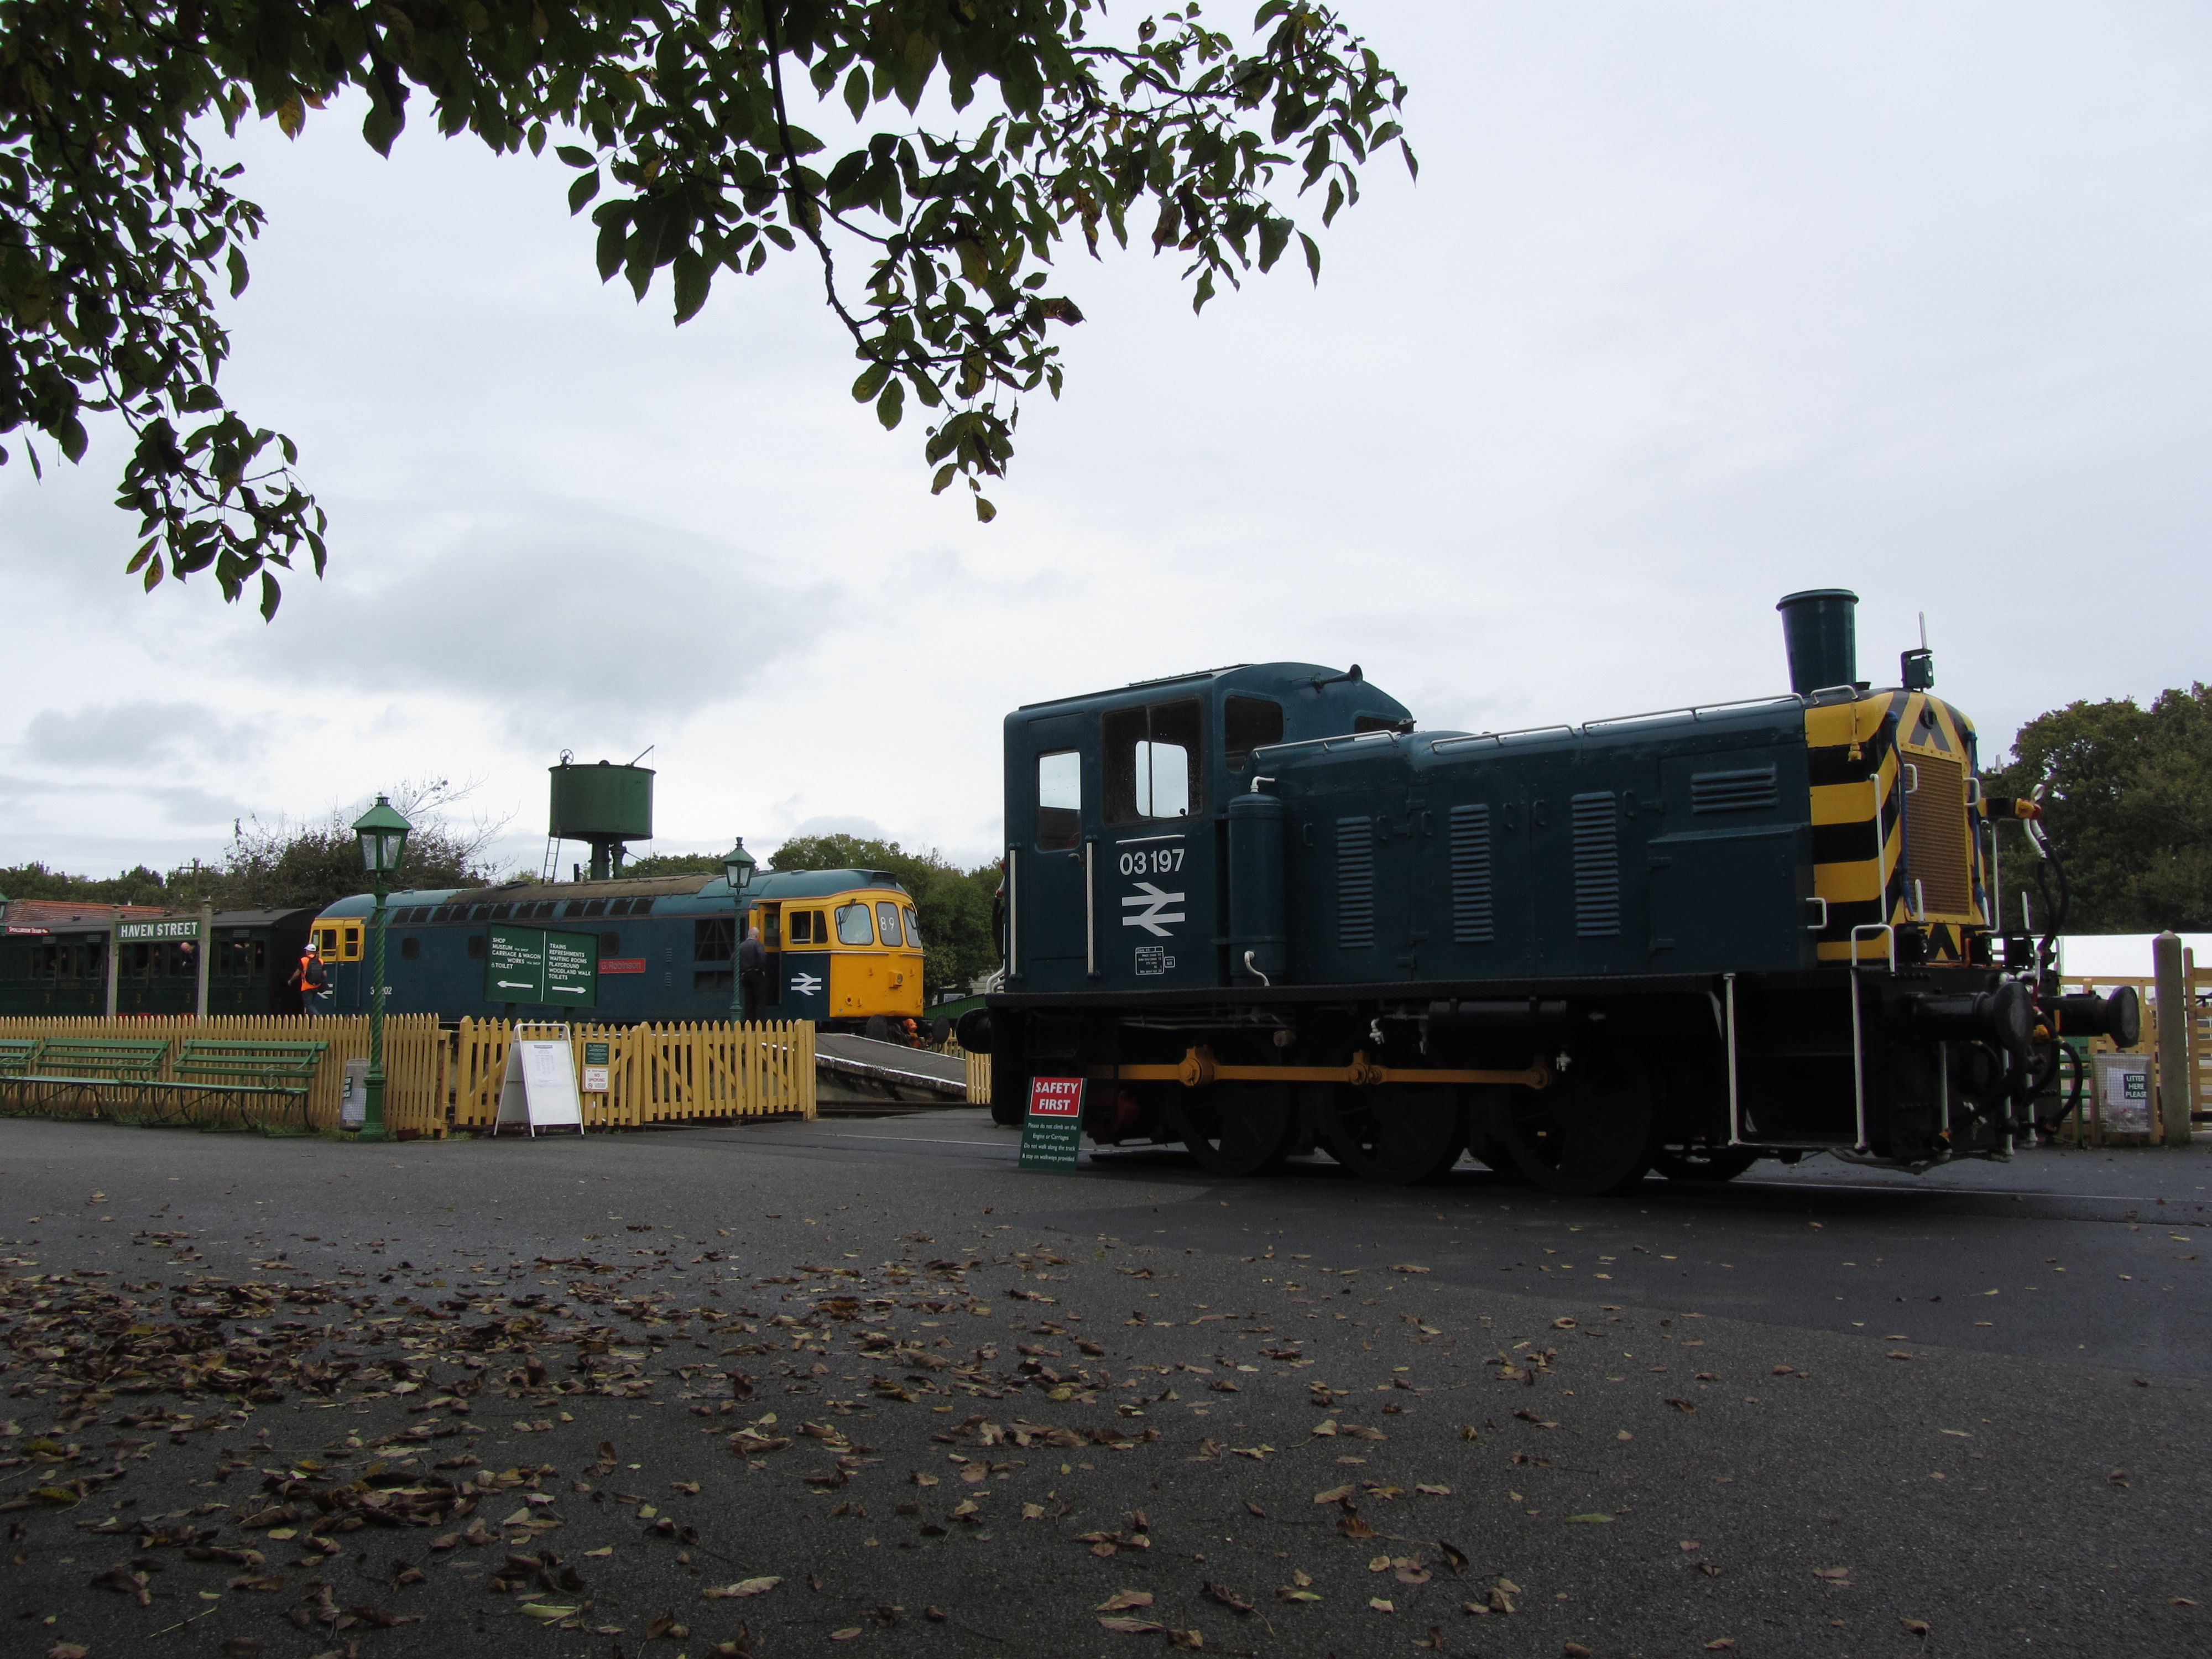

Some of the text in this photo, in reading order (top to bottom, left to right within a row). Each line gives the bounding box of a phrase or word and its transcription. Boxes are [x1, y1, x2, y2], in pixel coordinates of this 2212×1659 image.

[1119, 848, 1185, 875] 03 197
[121, 922, 197, 938] HAVEN STREET
[549, 949, 585, 957] REFRESHMENTS
[608, 961, 641, 970] Robinson
[45, 994, 51, 1004] 3
[90, 993, 95, 1004] 3
[135, 993, 142, 1004] 3
[185, 993, 191, 1003] 3
[237, 993, 243, 1003] 3
[1035, 1082, 1078, 1094] SAFETY
[1039, 1098, 1071, 1111] FIRST
